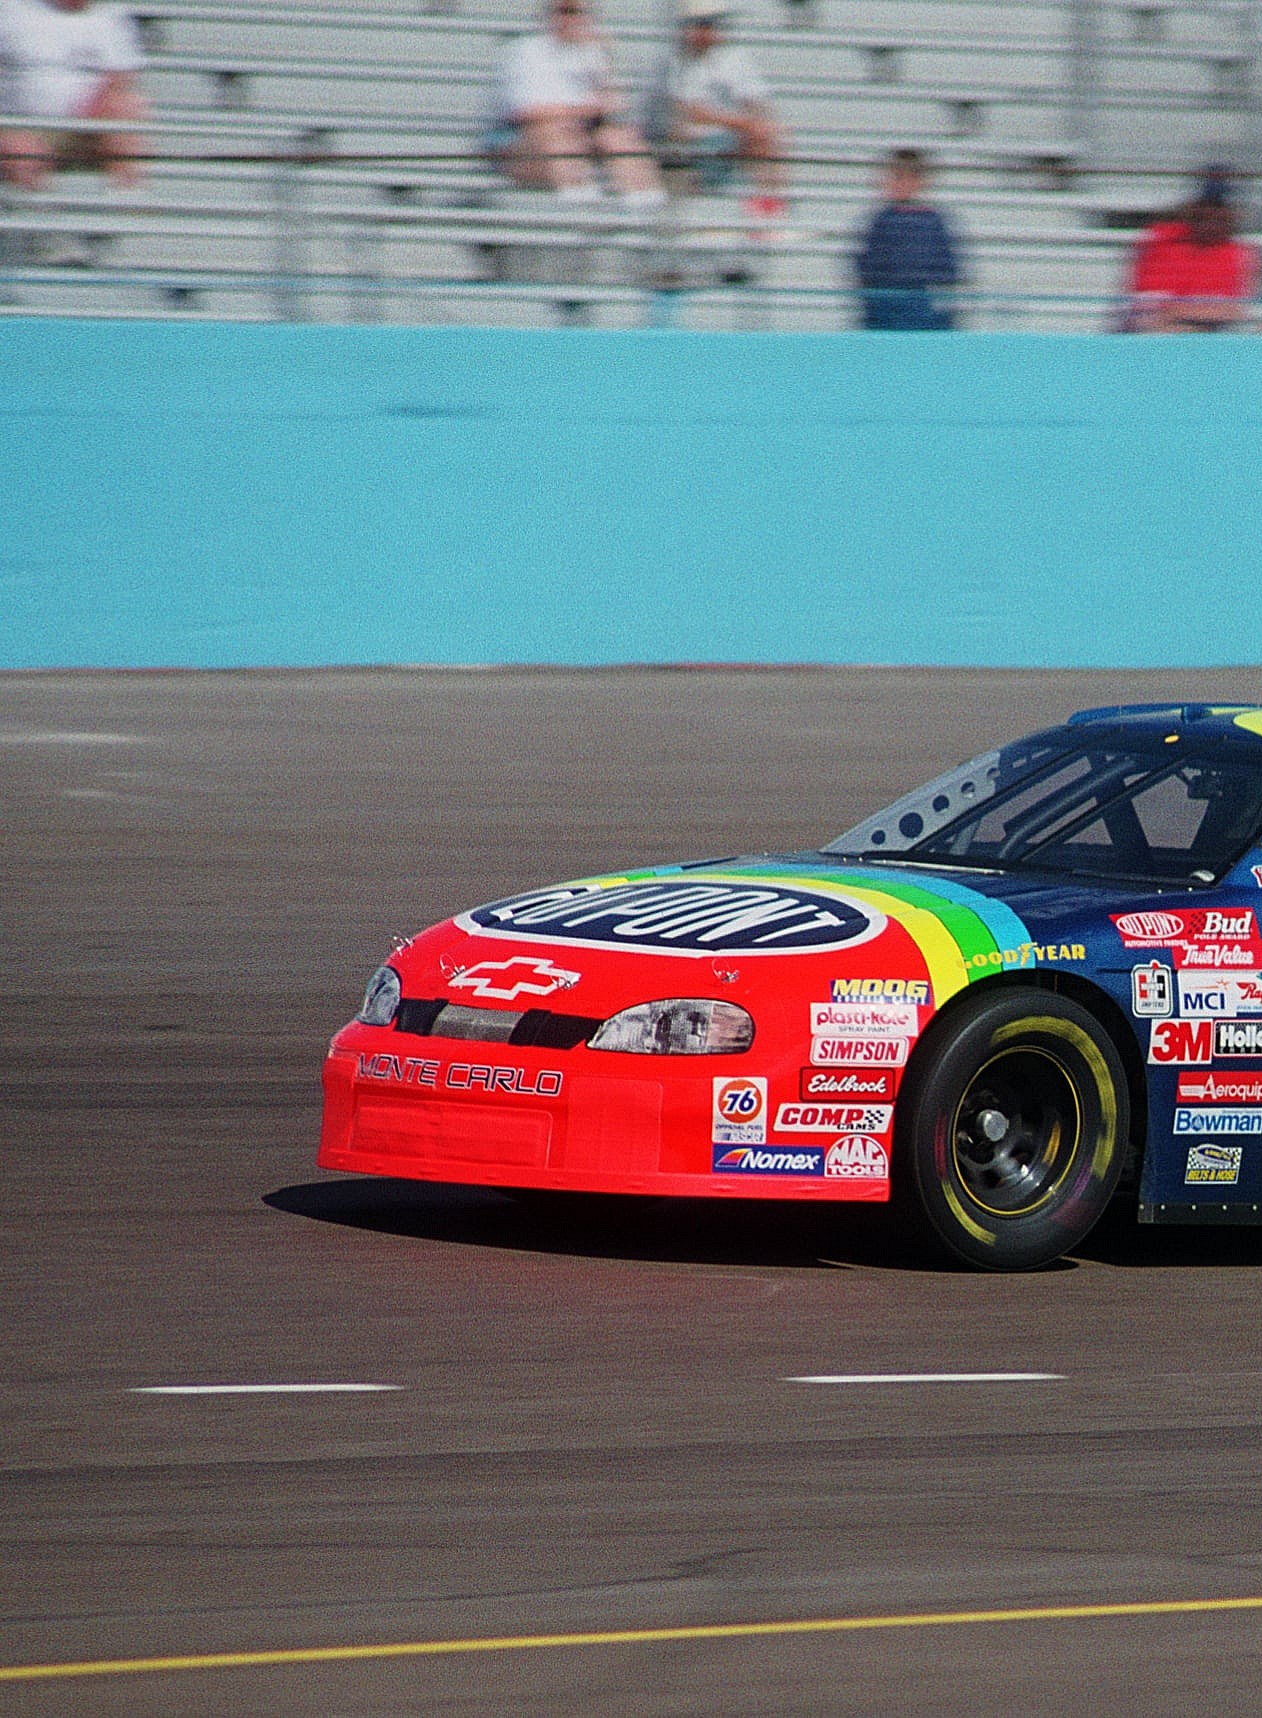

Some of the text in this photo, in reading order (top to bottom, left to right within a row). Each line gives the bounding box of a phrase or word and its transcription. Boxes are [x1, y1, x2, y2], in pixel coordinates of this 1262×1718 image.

[1203, 912, 1252, 934] Bud
[832, 979, 929, 998] MOOG
[1184, 993, 1226, 1010] MCI
[818, 1040, 899, 1061] SIMPSON
[1152, 1022, 1212, 1062] 3M
[357, 1053, 563, 1097] MONTE CARLO
[808, 1074, 887, 1094] Edelbrock
[722, 1088, 756, 1114] 76
[781, 1108, 864, 1126] COMP
[837, 1123, 876, 1131] CAMS
[1176, 1110, 1262, 1132] Bowman
[741, 1151, 819, 1170] Nomex
[828, 1164, 885, 1176] TOOLS
